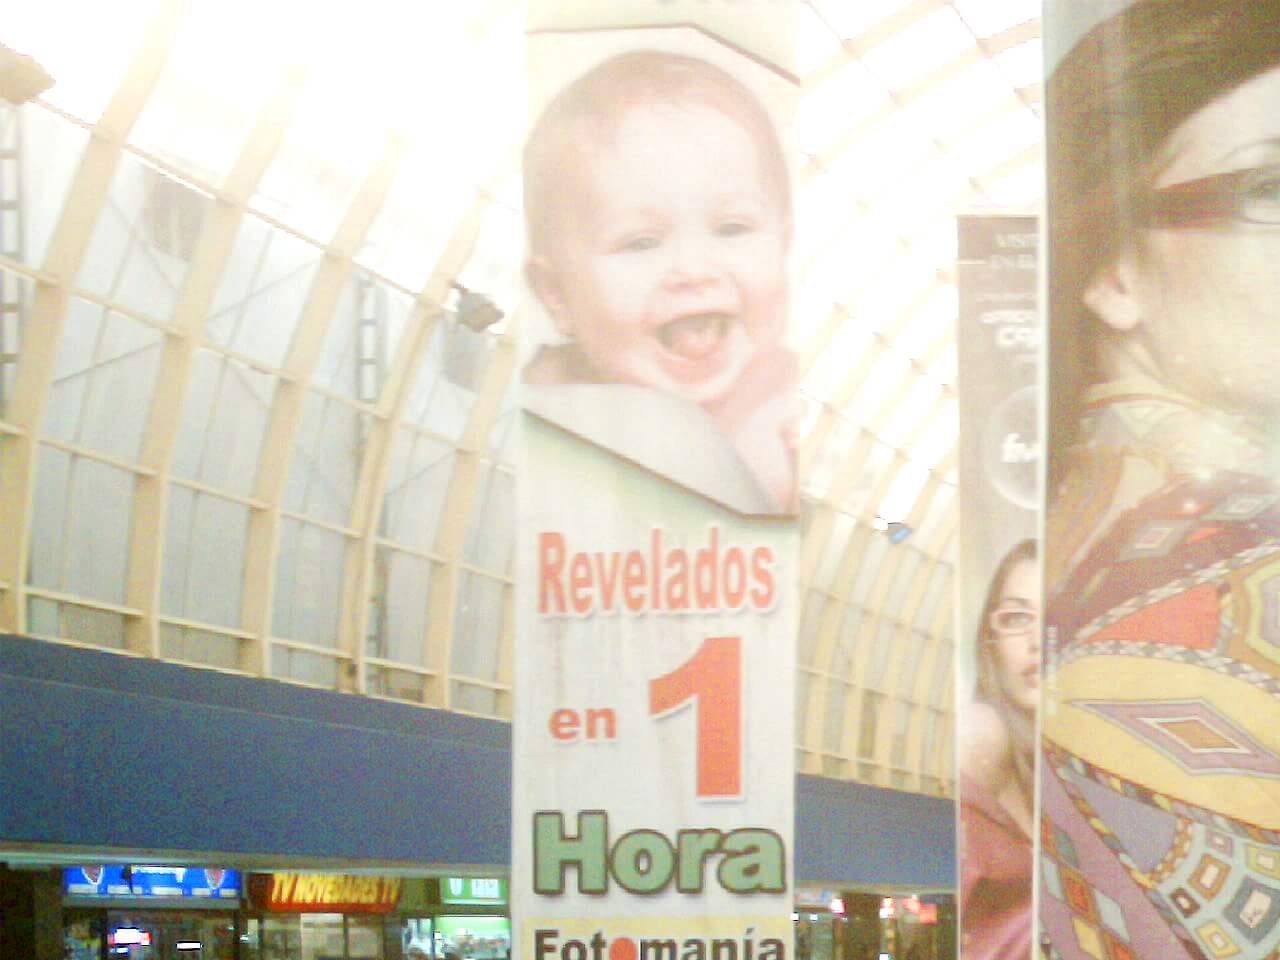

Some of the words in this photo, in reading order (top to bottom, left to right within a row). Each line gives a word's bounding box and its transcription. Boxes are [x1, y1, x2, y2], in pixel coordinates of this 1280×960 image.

[536, 526, 776, 615] Revelados
[548, 706, 617, 740] en
[649, 635, 742, 797] 1
[532, 809, 788, 896] Hora
